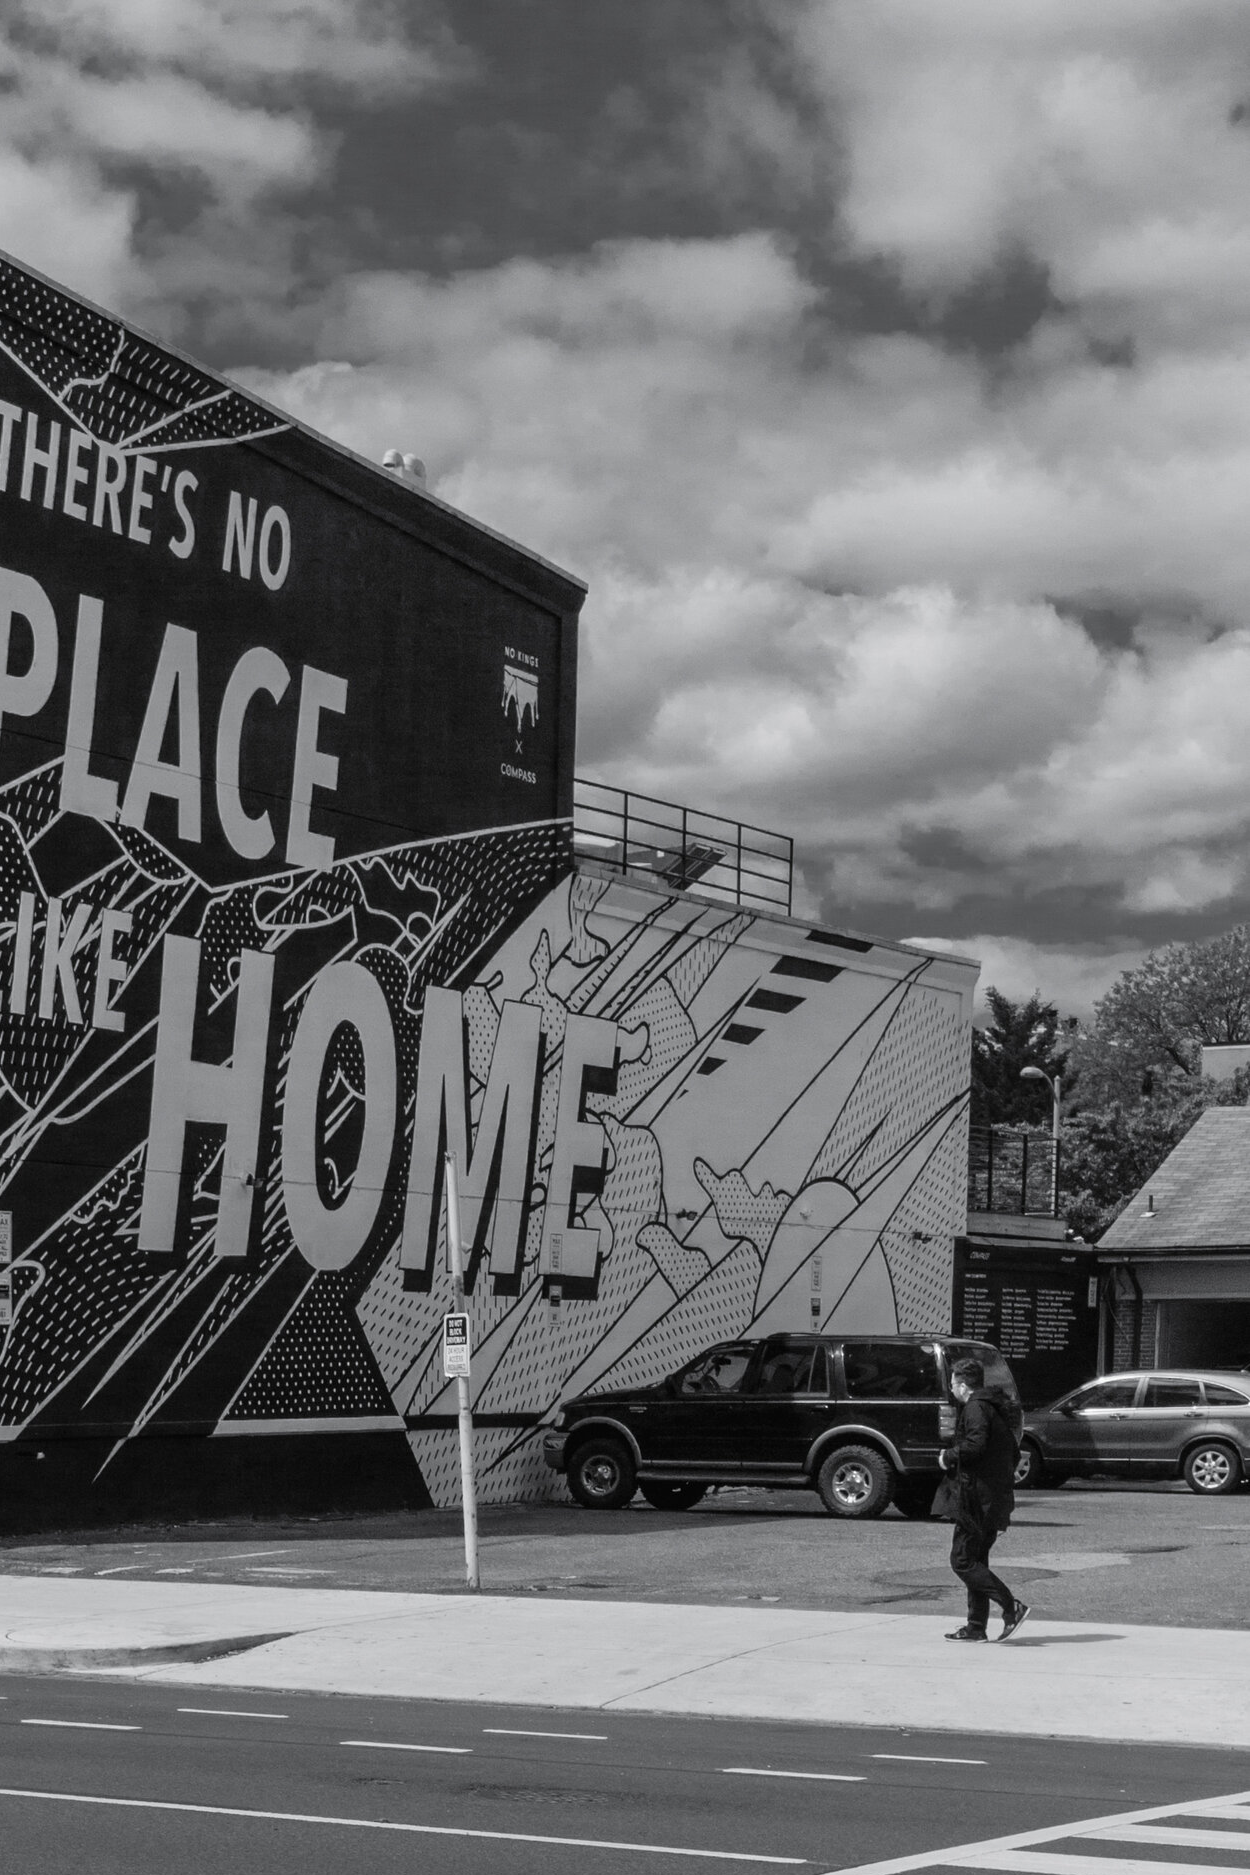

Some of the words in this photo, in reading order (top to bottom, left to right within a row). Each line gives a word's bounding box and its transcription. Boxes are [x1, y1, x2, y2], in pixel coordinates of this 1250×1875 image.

[222, 490, 291, 591] NO
[504, 645, 516, 659] NO
[517, 651, 539, 668] KINGS
[500, 762, 537, 785] COMPASS
[137, 933, 618, 1278] HOME
